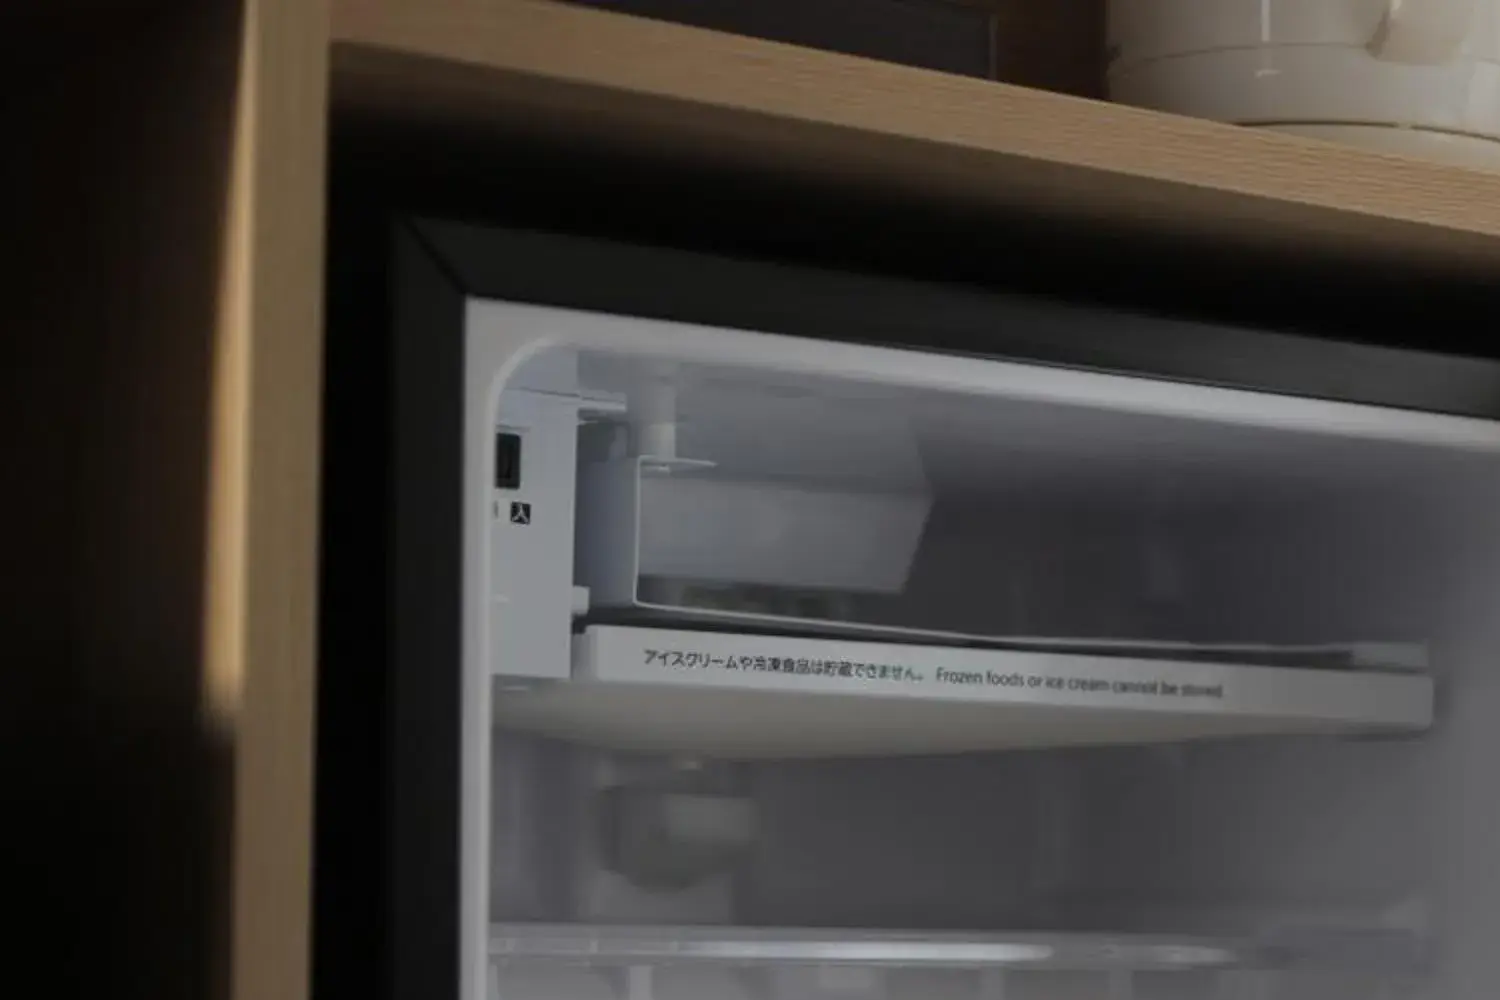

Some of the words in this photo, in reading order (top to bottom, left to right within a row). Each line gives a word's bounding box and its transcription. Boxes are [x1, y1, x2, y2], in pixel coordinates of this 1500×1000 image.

[643, 649, 924, 682] アイスクリームや冷凍食品は貯蔵できません。
[936, 666, 983, 684] Frozen
[986, 670, 1024, 688] foods
[1028, 677, 1042, 688] or
[1046, 675, 1065, 690] ice
[1068, 679, 1110, 692] cream
[1113, 680, 1158, 696] cannot
[1161, 682, 1178, 697] be
